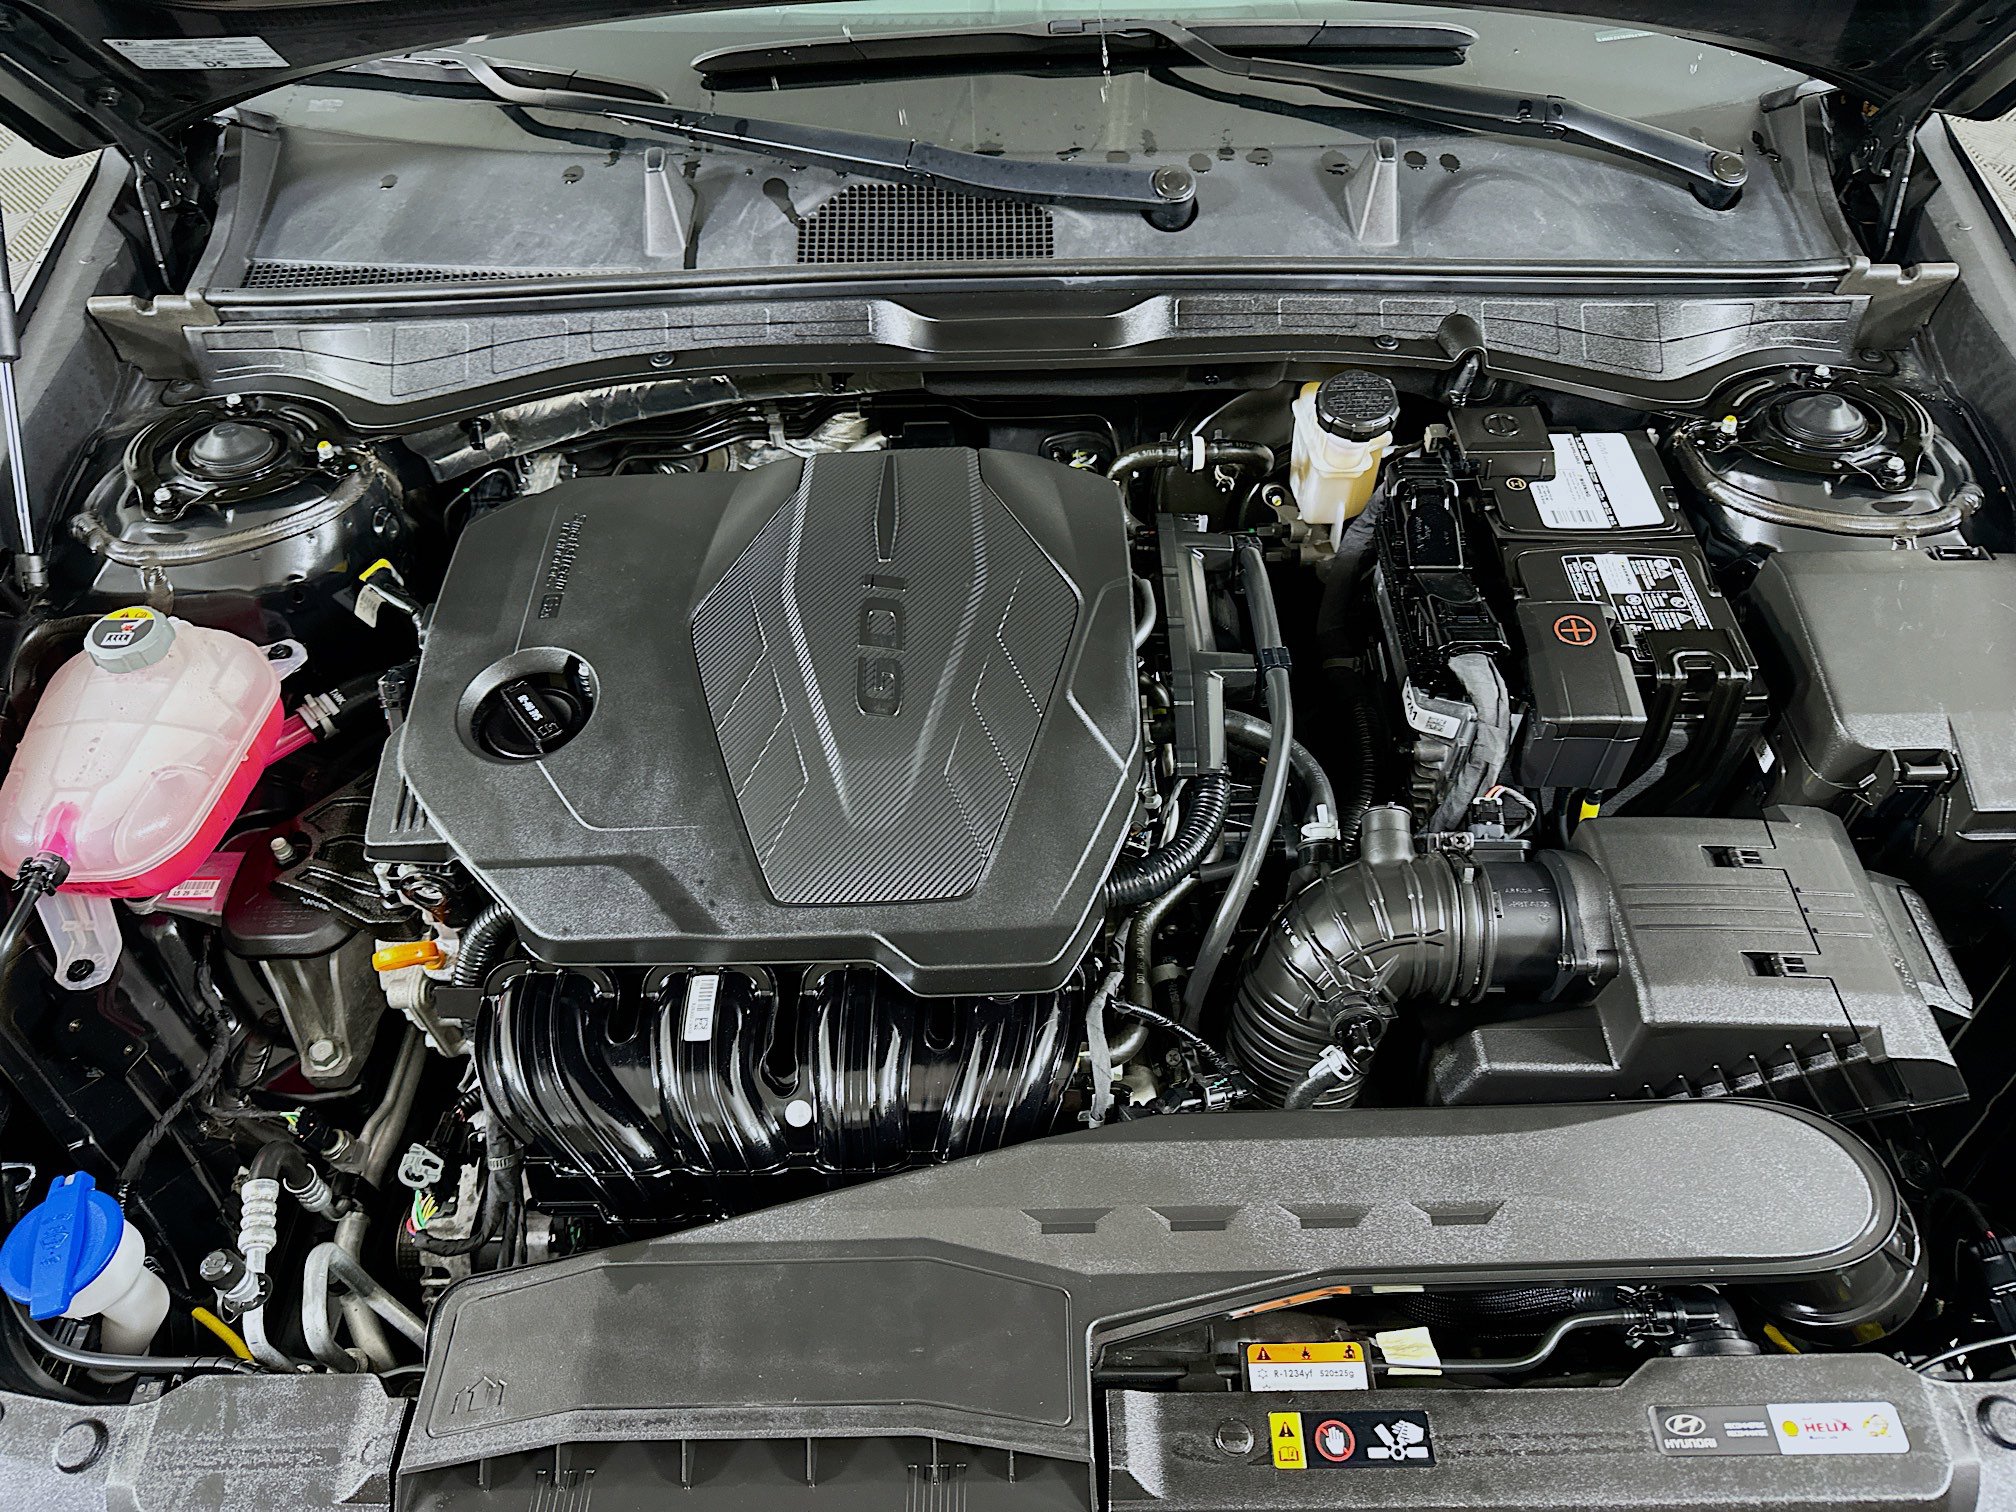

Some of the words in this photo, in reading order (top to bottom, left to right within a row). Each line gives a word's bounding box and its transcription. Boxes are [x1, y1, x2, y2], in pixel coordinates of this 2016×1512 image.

[1273, 1369, 1313, 1379] R-1234yf
[1319, 1369, 1355, 1378] 520±25g
[1804, 1419, 1853, 1432] HELIX
[1663, 1437, 1718, 1449] HYUNDAI
